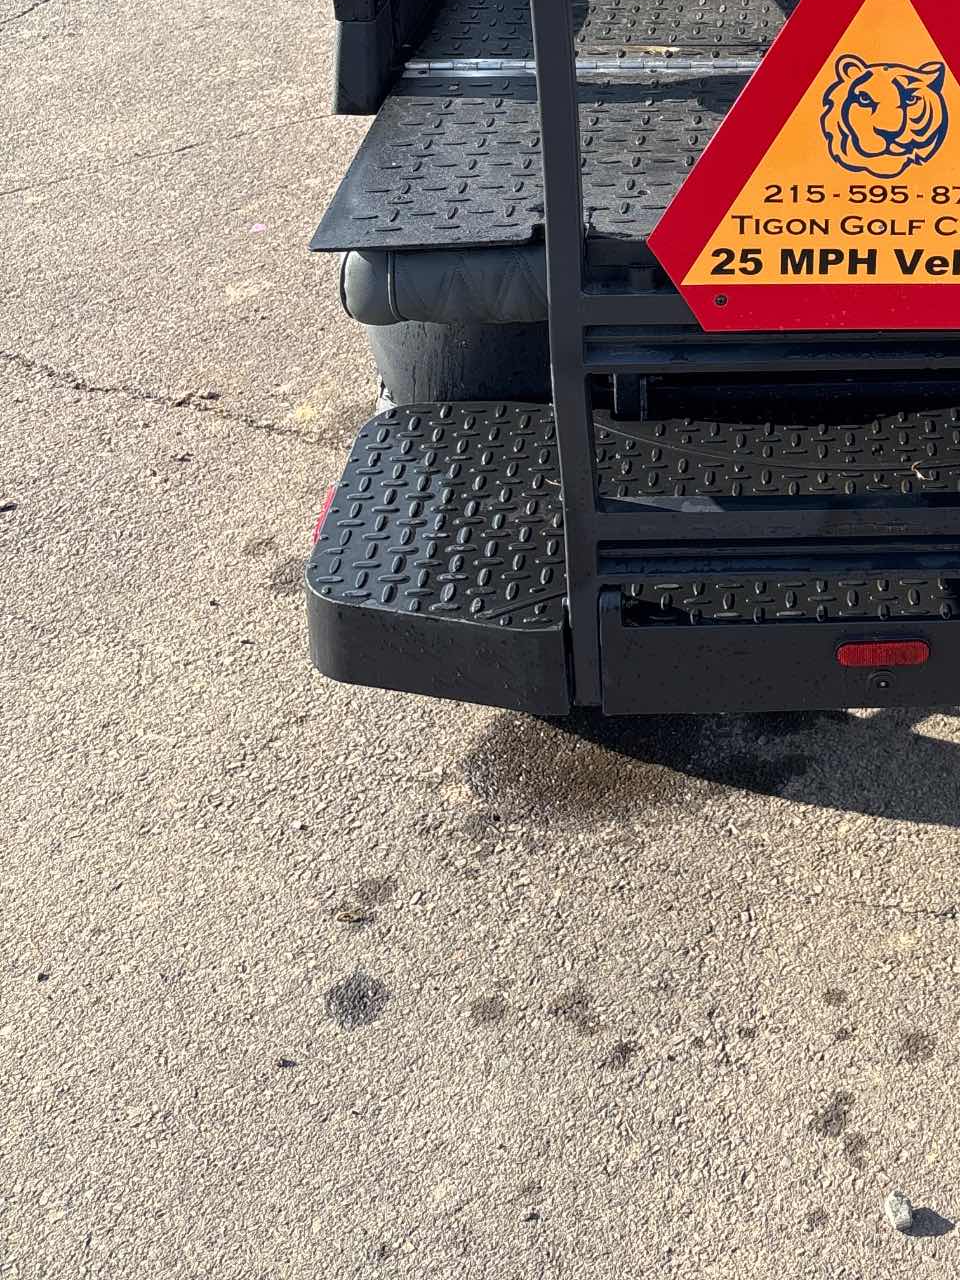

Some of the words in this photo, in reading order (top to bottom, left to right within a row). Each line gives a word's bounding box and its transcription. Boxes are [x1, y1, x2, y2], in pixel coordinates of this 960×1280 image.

[731, 215, 830, 235] TIGON
[840, 215, 925, 236] GOLF
[710, 247, 763, 276] 25
[780, 248, 877, 275] MPH
